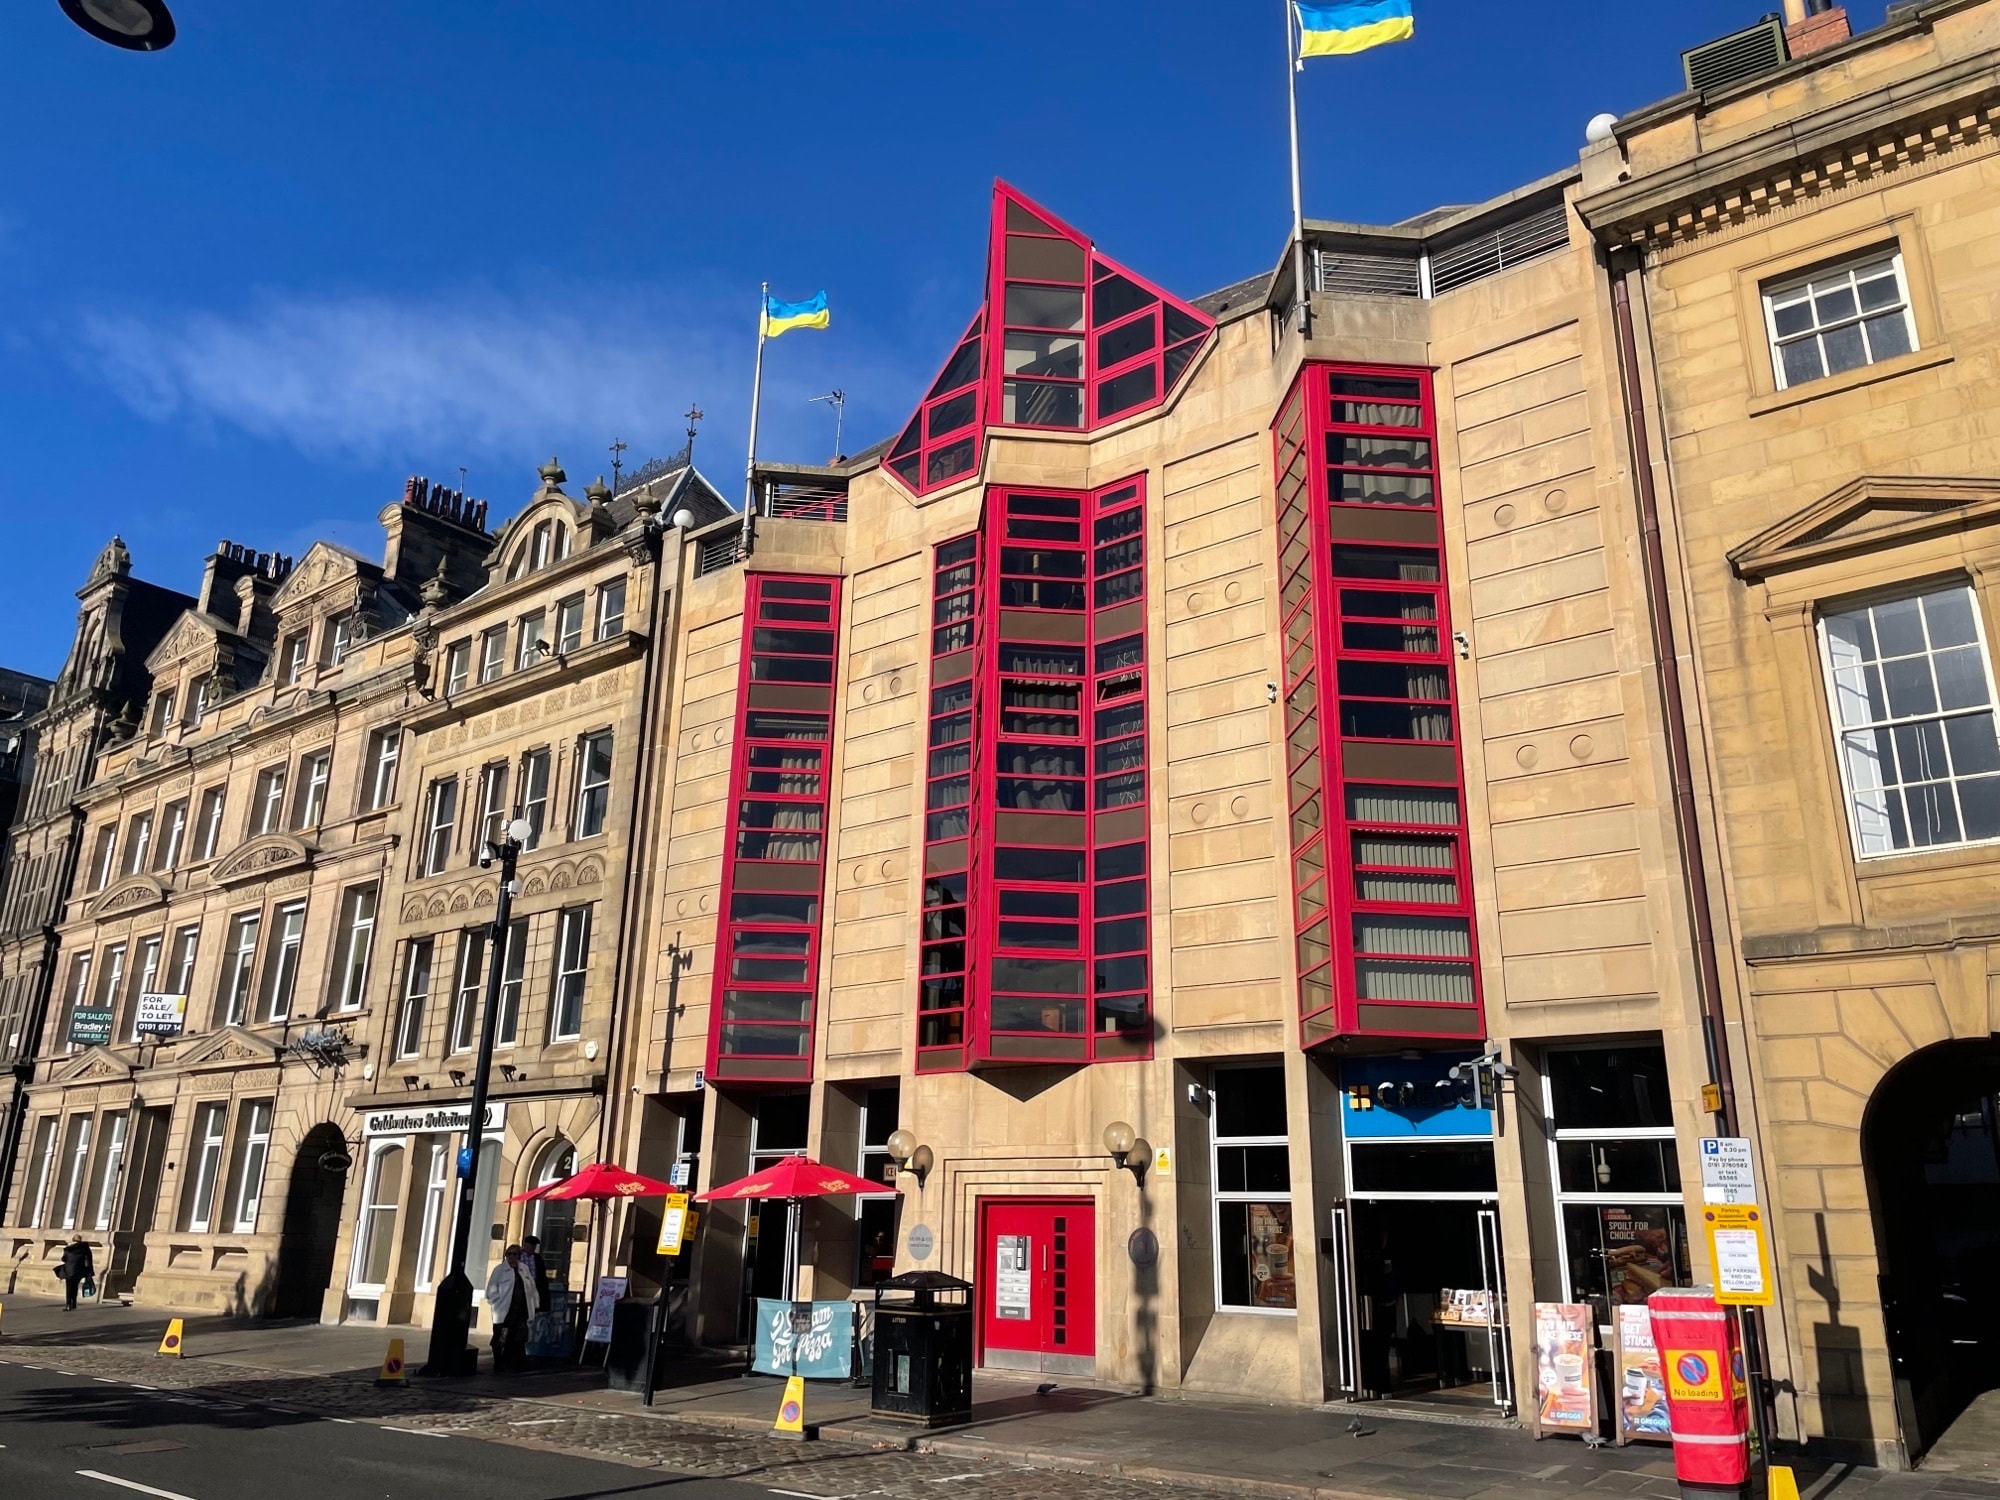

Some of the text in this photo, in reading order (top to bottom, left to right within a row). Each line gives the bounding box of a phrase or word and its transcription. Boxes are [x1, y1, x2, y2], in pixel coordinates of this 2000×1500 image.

[74, 1012, 87, 1020] FOR
[74, 1022, 104, 1032] Bradley
[1376, 1079, 1475, 1109] GREGG
[369, 1110, 472, 1131] Goldwaters Solicitor
[564, 1156, 572, 1170] 2
[1608, 1222, 1649, 1230] SPOILT FOR
[1610, 1231, 1635, 1240] CHOICE
[784, 1306, 834, 1338] Sam
[1624, 1324, 1640, 1334] GET
[1624, 1336, 1654, 1347] STUCK
[772, 1332, 832, 1370] For Pizza
[1688, 1388, 1719, 1398] loading
[1556, 1411, 1582, 1420] GREGGS
[1640, 1418, 1667, 1426] GREGGS
